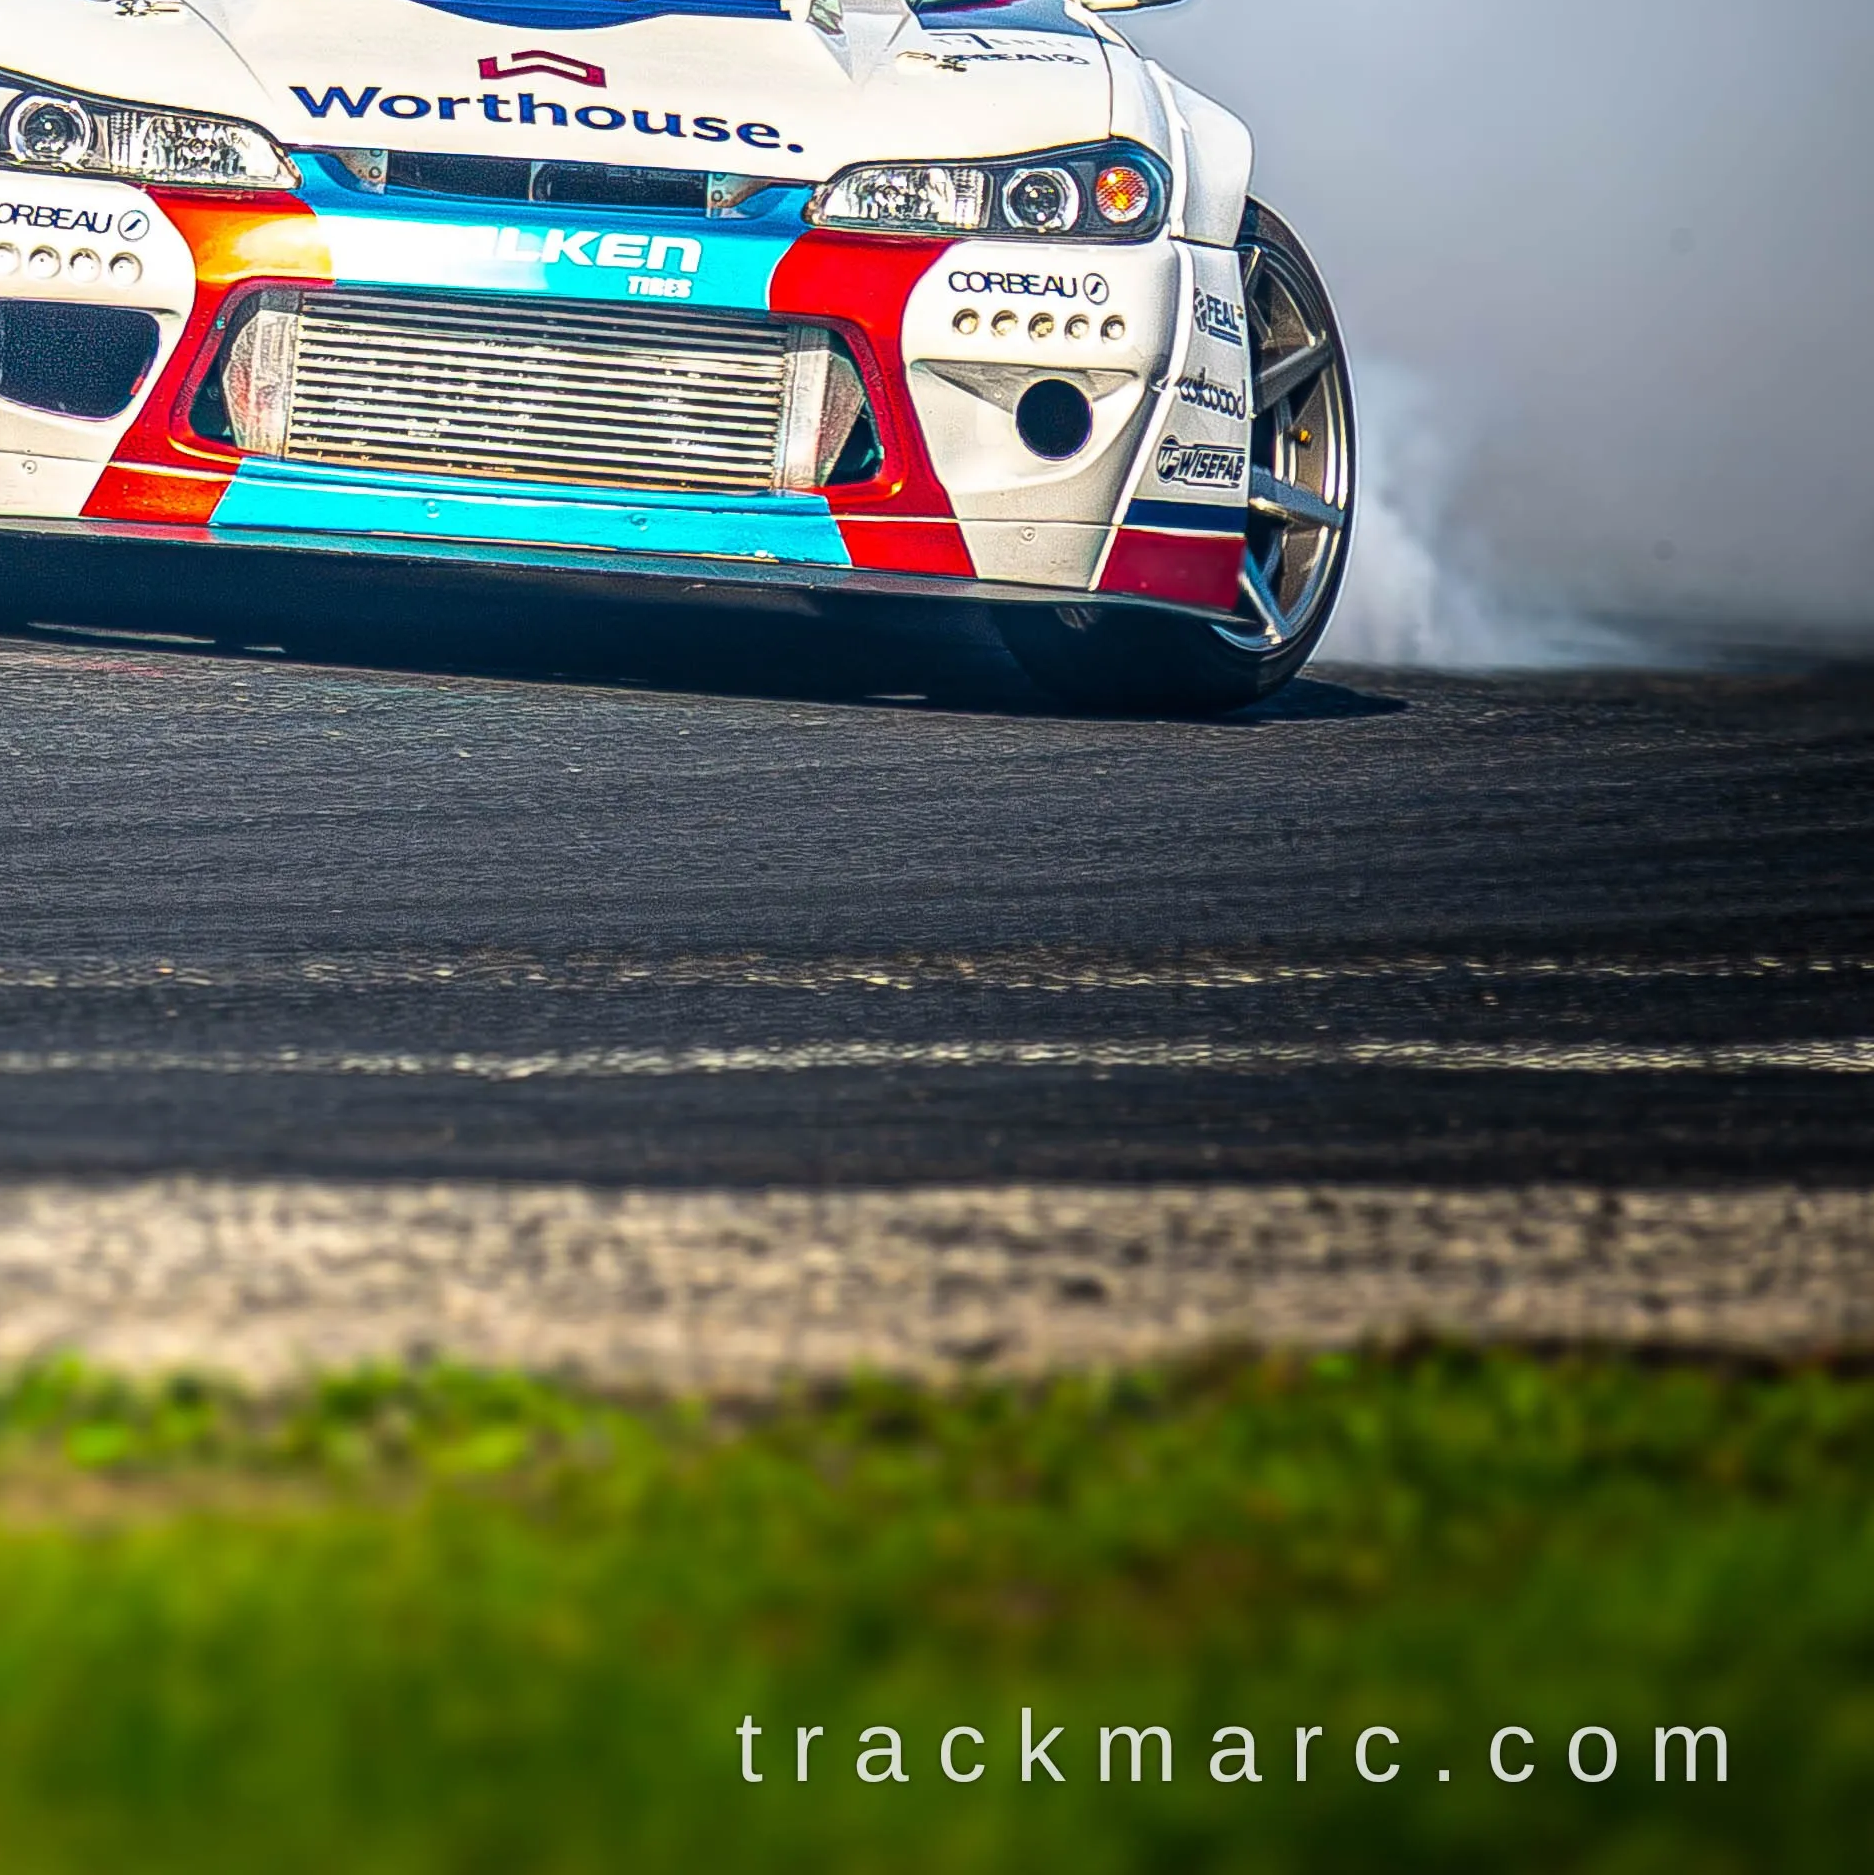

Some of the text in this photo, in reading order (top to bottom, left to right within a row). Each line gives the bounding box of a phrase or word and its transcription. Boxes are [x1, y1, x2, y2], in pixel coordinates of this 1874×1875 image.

[288, 85, 805, 155] Worthouse.
[627, 274, 693, 299] TIRES
[948, 269, 1078, 300] CORBEAU
[1205, 292, 1240, 332] FEAL
[1178, 449, 1247, 481] WISEFAB
